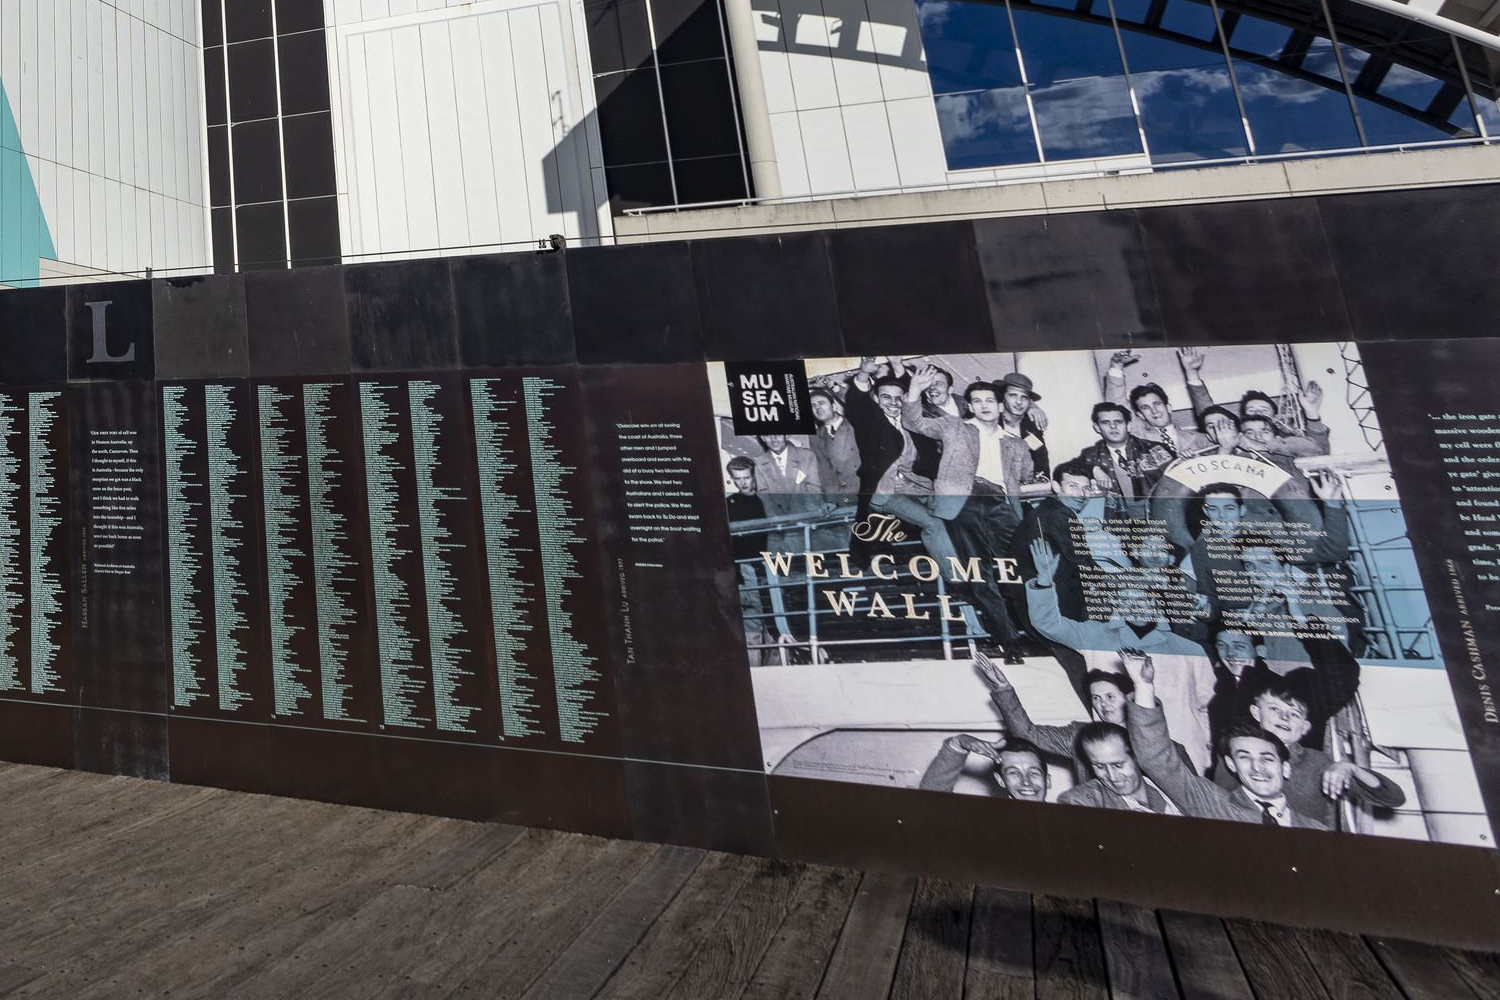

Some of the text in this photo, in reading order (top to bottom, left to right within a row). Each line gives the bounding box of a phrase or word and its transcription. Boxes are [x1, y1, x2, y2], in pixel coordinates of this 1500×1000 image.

[740, 374, 773, 389] MU
[742, 390, 785, 406] SEA
[744, 406, 779, 422] UM
[1186, 459, 1265, 478] TOSCANA
[852, 512, 907, 543] The
[759, 551, 1024, 584] WELCOME
[823, 590, 966, 622] WALL
[1460, 620, 1486, 681] CASHMAN
[1477, 684, 1499, 723] DENIS
